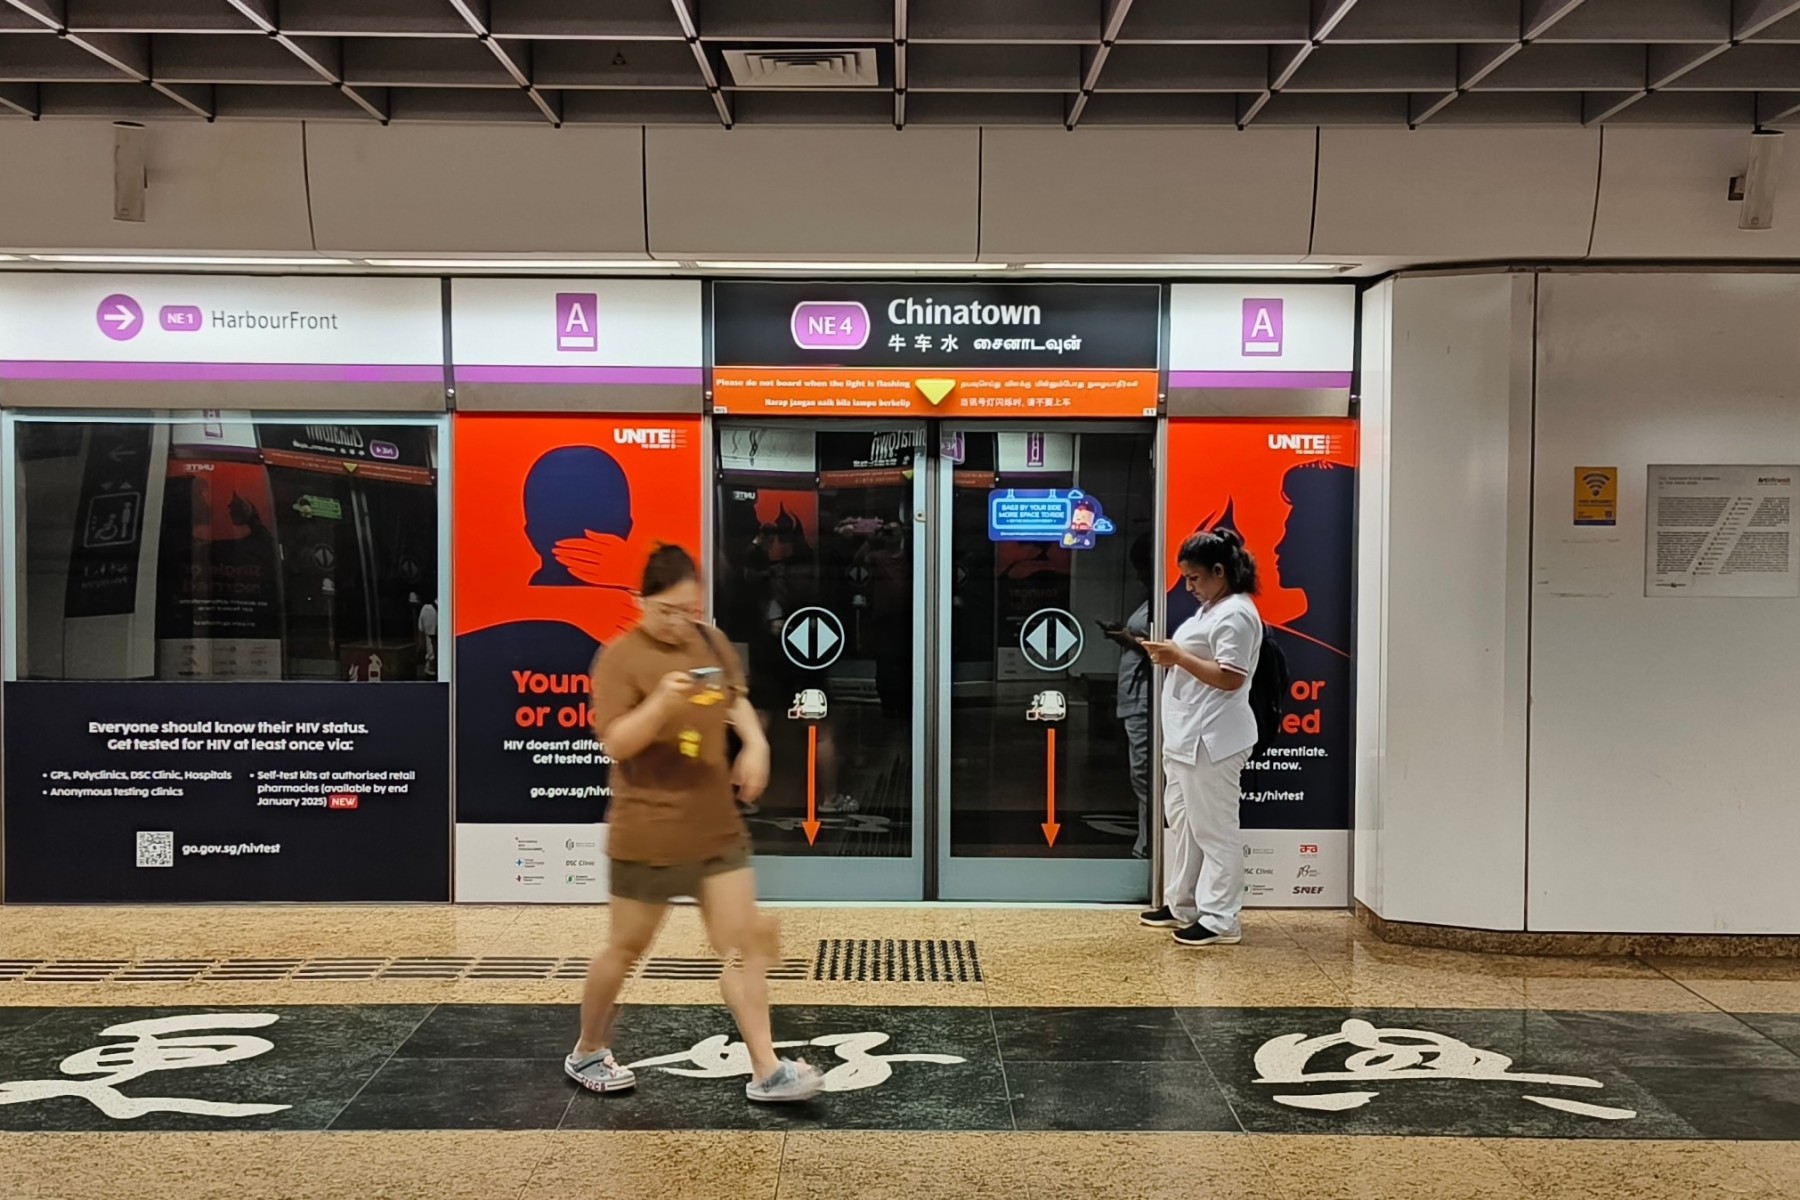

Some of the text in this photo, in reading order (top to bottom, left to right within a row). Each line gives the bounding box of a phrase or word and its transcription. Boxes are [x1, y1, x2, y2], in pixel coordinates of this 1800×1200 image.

[888, 297, 1041, 325] Chinatown
[212, 311, 338, 330] HarbourFront
[565, 302, 589, 333] A
[1251, 308, 1275, 337] A
[715, 379, 910, 389] Please do not board when the light is flashing
[765, 398, 911, 409] Harap jangan naik bila lampu berkelip
[613, 428, 671, 444] UNITE
[1268, 434, 1325, 449] UNITE
[512, 671, 594, 693] Youn
[1290, 680, 1326, 700] or
[515, 706, 550, 727] or
[1281, 709, 1321, 734] ed
[89, 721, 368, 735] Everyone should know their HIV status.
[108, 738, 353, 750] Get tested for HIV at least once via:
[503, 740, 607, 750] HIV doesn't differ
[533, 754, 619, 764] Get tested no.
[1244, 760, 1302, 771] sted now.
[50, 770, 232, 781] GPs, Polyclinics, DSC Clinic, Hospitals
[258, 770, 298, 779] Self-test
[300, 771, 317, 779] kits
[332, 771, 387, 779] authorised
[389, 771, 415, 779] retail
[50, 787, 183, 798] Anonymous testing clinics
[258, 784, 408, 795] pharmacies (available by end
[530, 786, 616, 799] go.gov.sg/hivt
[257, 797, 356, 807] January 2025) NEW
[182, 843, 280, 855] go.gov.sg/hivtest
